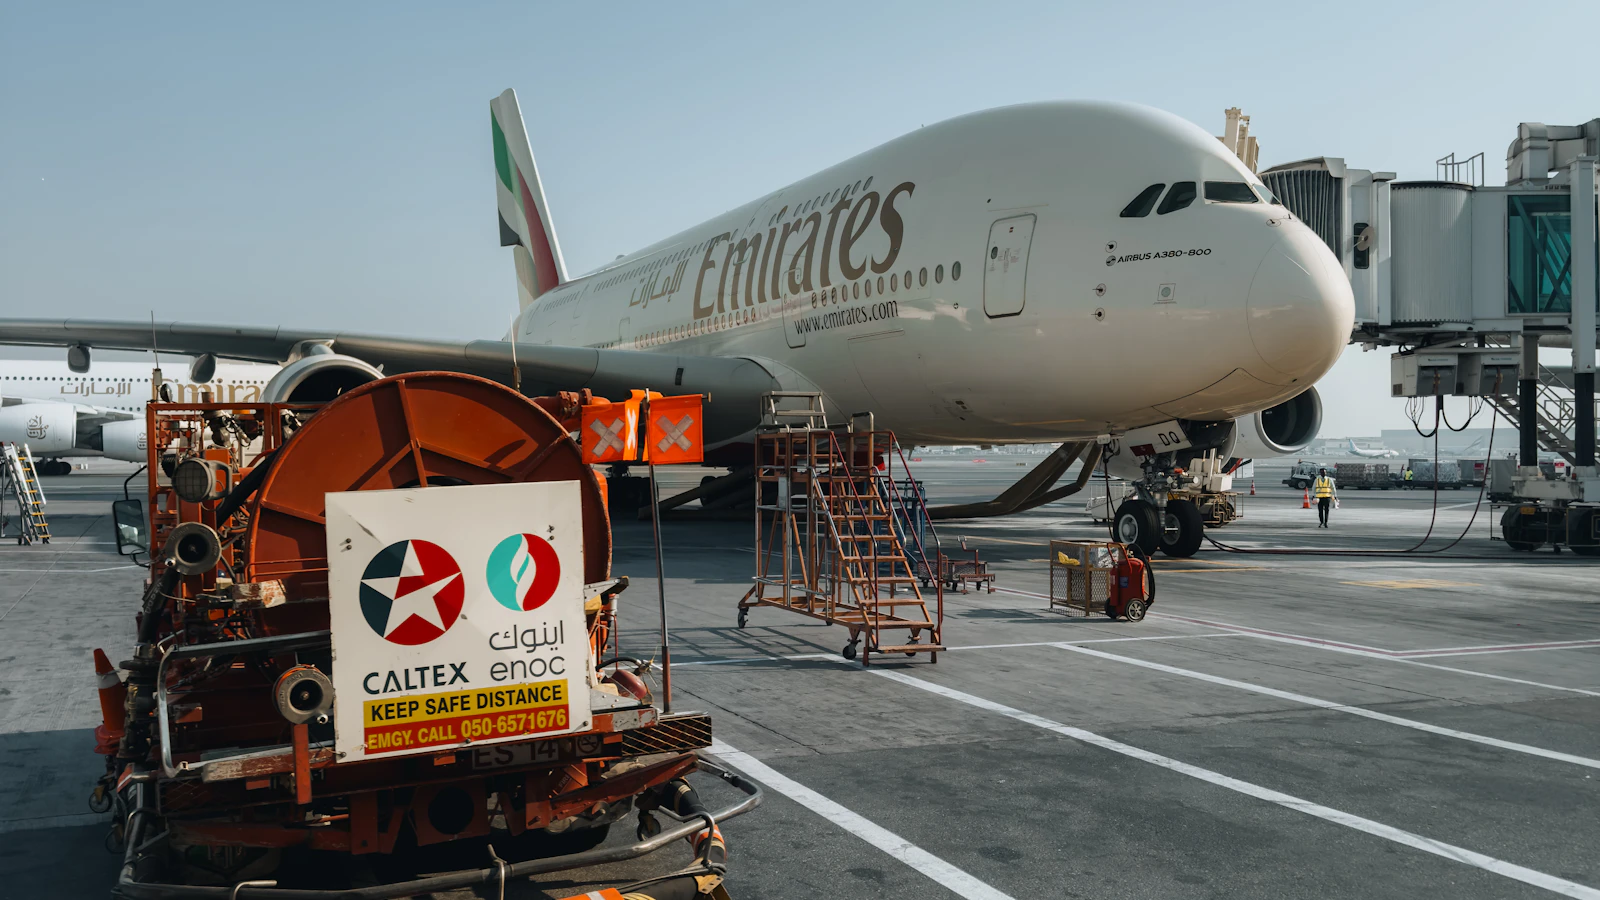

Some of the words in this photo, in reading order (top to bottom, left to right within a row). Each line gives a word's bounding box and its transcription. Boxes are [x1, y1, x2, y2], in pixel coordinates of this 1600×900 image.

[693, 181, 916, 320] Emirates
[1117, 253, 1151, 263] AIRBUS
[1153, 248, 1212, 259] A380-800
[794, 300, 899, 335] www.emirates.com
[1158, 431, 1181, 446] DQ
[363, 661, 469, 694] CALTEX
[490, 656, 566, 681] enoc
[371, 700, 419, 722] KEEP
[425, 695, 470, 716] SAFE
[477, 685, 562, 710] DISTANCE
[368, 731, 414, 750] EMGY.
[418, 724, 457, 743] CALL
[461, 708, 566, 738] 050-6571676
